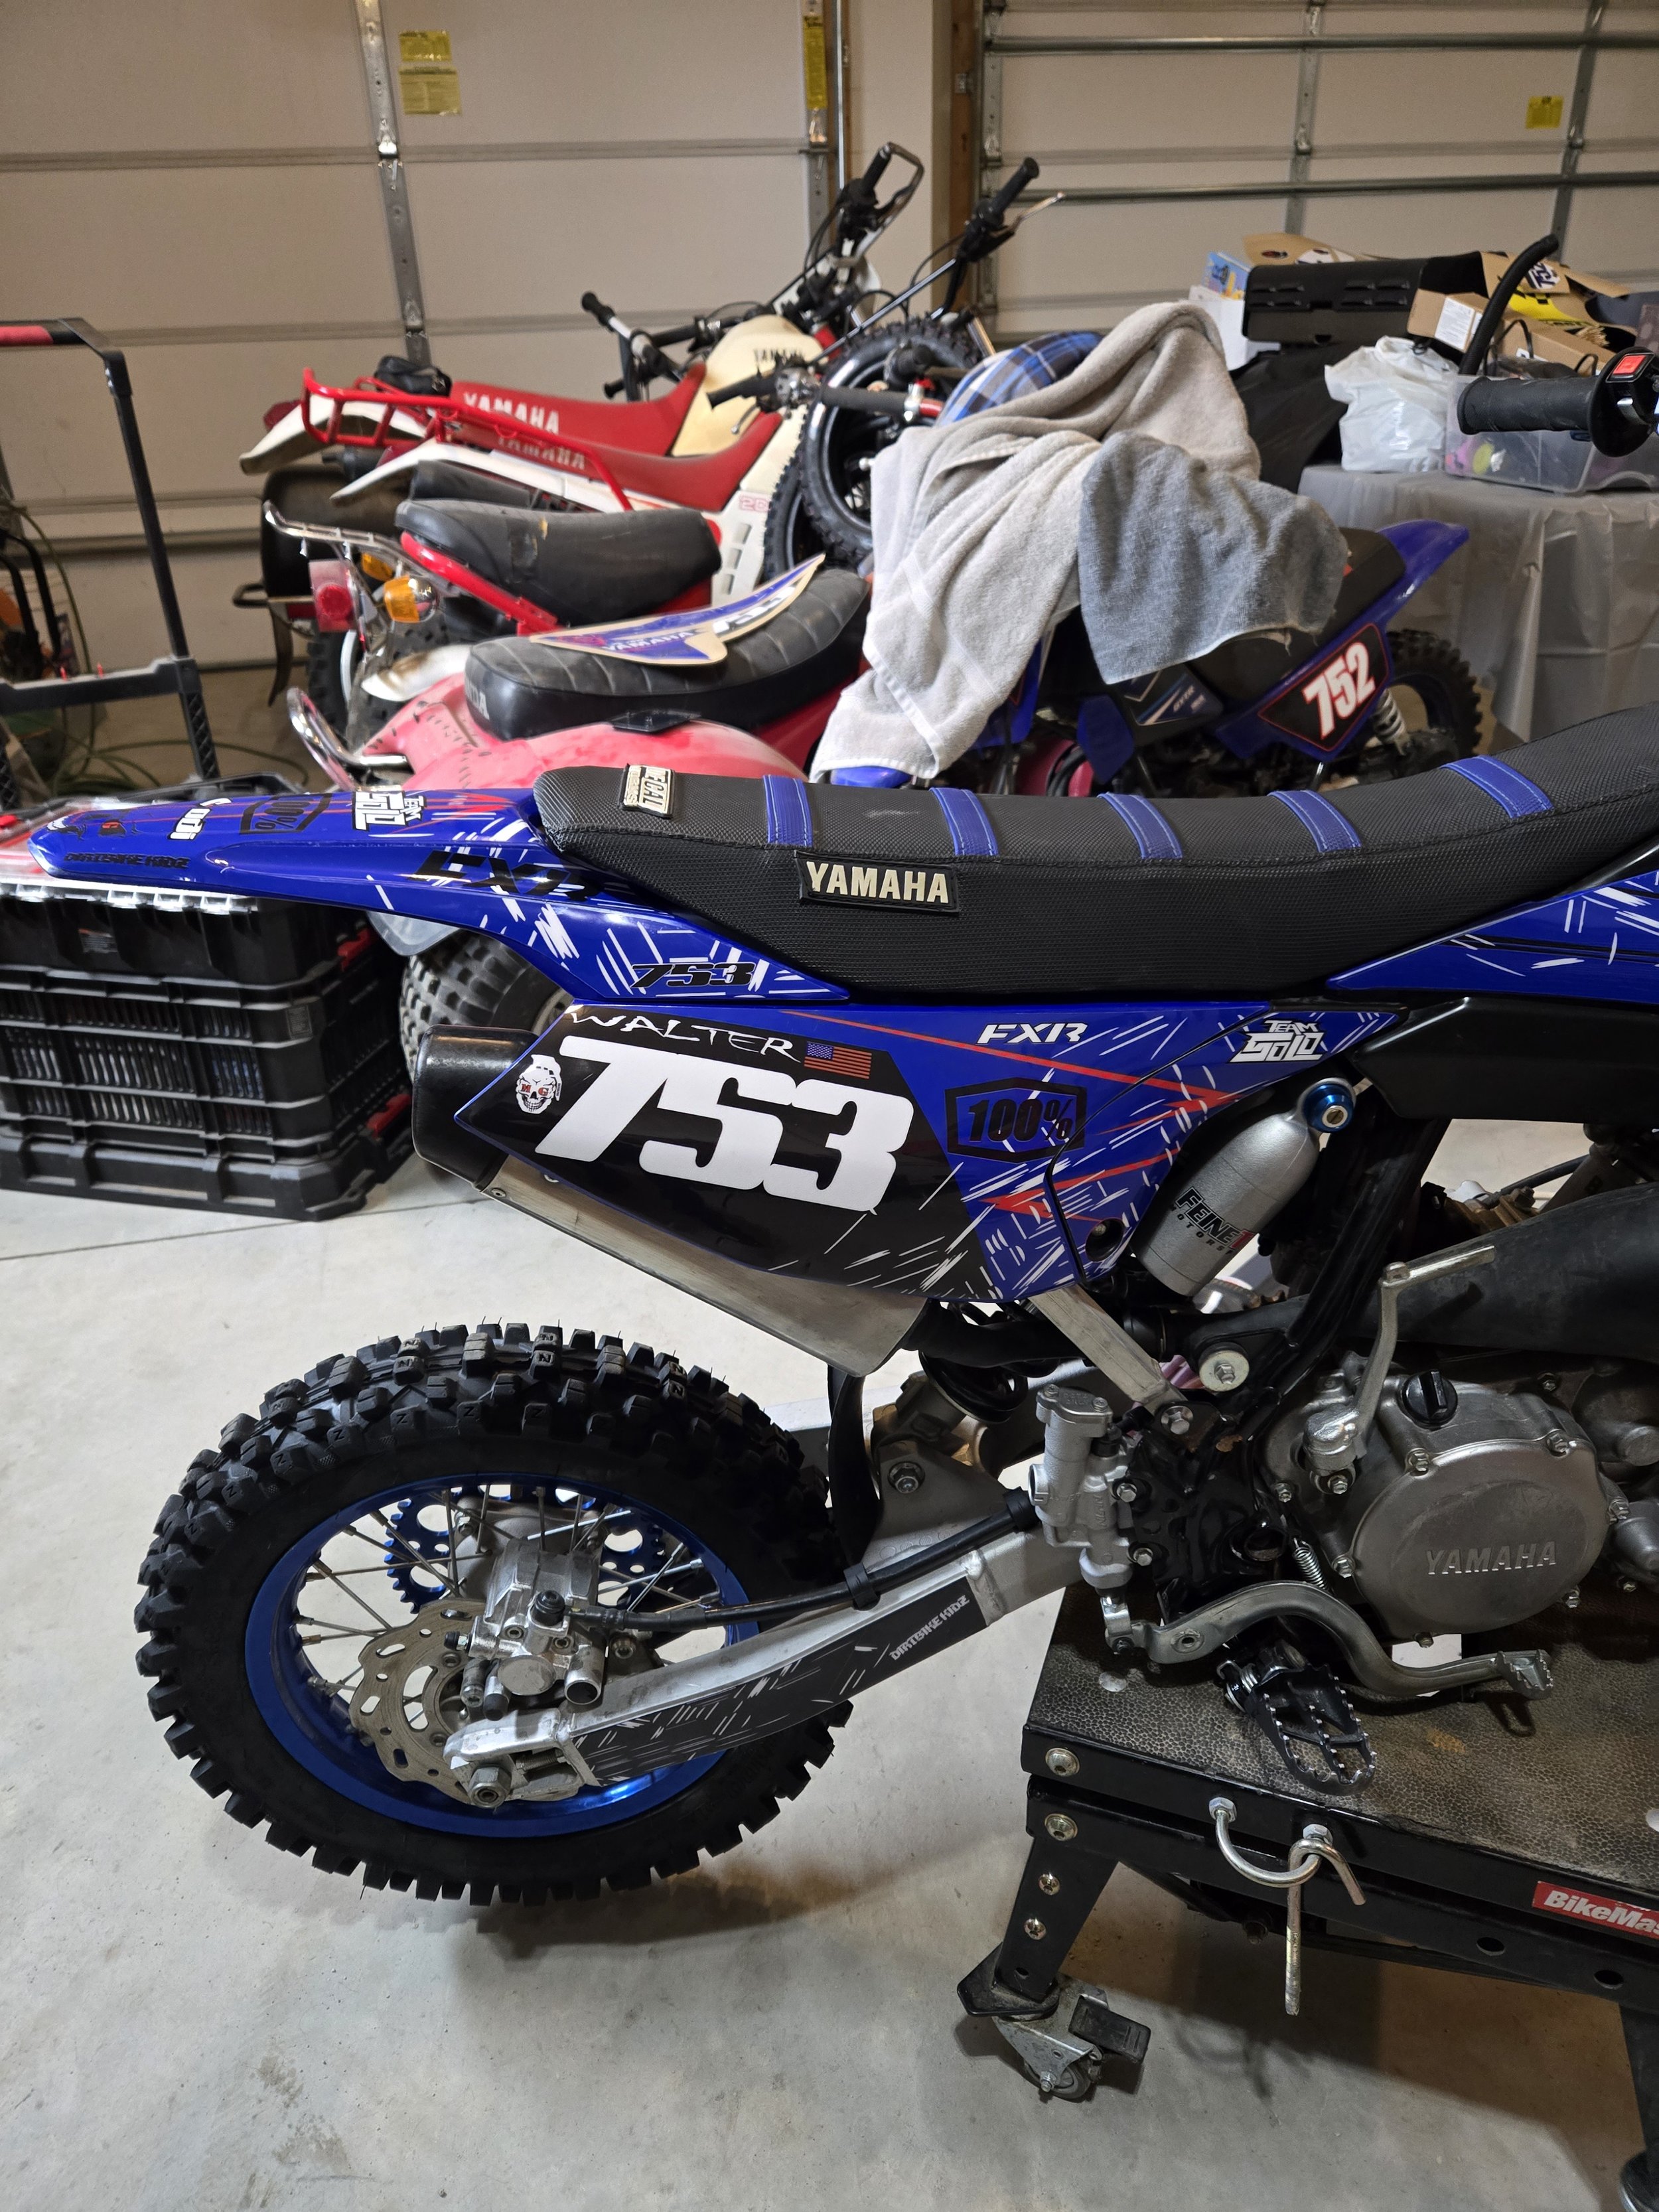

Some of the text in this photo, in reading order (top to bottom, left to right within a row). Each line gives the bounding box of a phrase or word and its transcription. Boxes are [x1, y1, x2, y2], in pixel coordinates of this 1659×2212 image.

[464, 393, 559, 435] YAMAHA
[1301, 641, 1376, 740] 752
[399, 795, 425, 822] TEAM
[806, 861, 949, 904] YAMAHA
[630, 962, 756, 989] 753
[570, 1013, 802, 1063] WALTER
[977, 1023, 1088, 1044] FXR
[1264, 1020, 1319, 1035] TEAM
[1230, 1032, 1325, 1063] SOLO
[535, 1035, 914, 1212] 753
[968, 1098, 1073, 1142] 100%
[1427, 1541, 1556, 1576] YAMAHA
